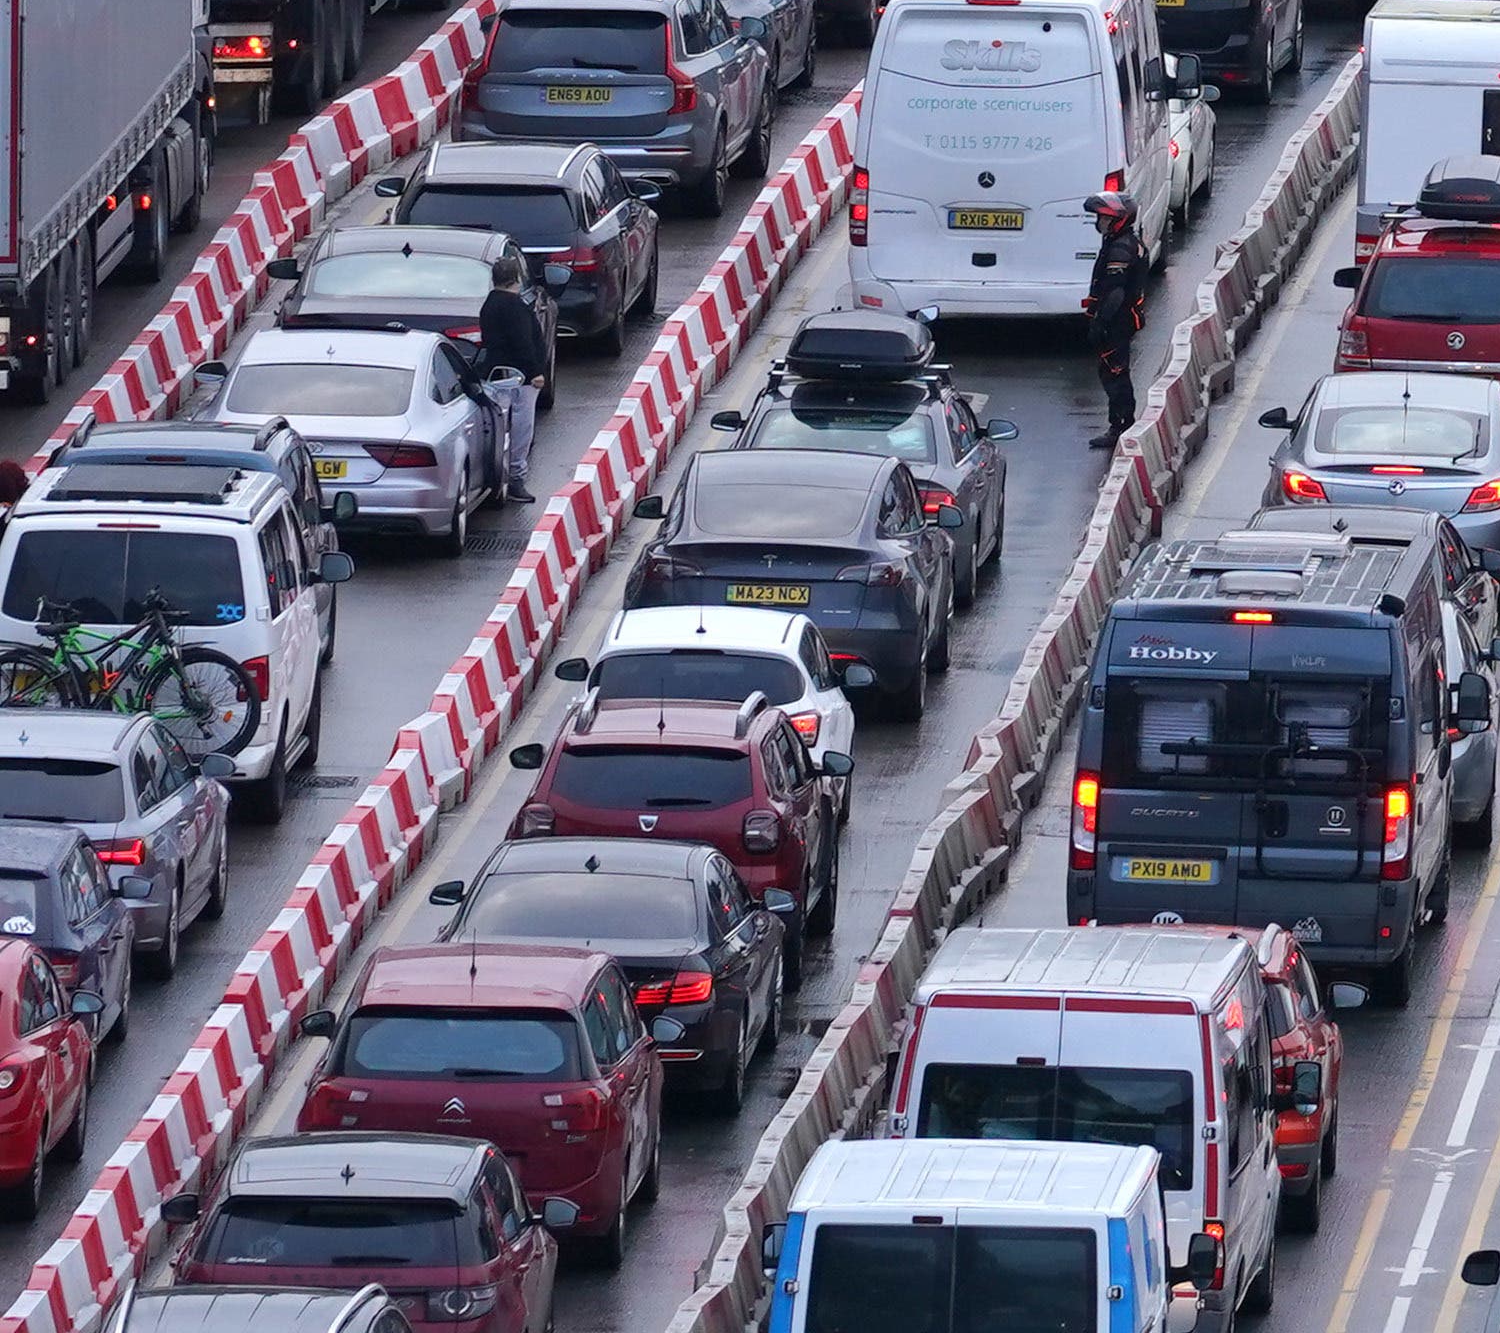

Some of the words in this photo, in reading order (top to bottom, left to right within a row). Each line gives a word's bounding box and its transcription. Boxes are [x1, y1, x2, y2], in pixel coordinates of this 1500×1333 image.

[940, 38, 1042, 73] Skills
[549, 88, 582, 101] EN69
[908, 97, 977, 114] corporate
[983, 98, 1073, 114] scenicruisers
[939, 134, 979, 150] 0115
[983, 135, 1020, 150] 9777
[1024, 136, 1053, 151] 426
[959, 213, 989, 228] RX16
[991, 214, 1019, 229] XHH
[735, 585, 774, 602] MA23
[778, 586, 808, 603] NCX
[1128, 646, 1219, 664] Hobby
[1131, 860, 1166, 877] PX19
[1170, 862, 1202, 879] AMO
[7, 923, 31, 934] UK
